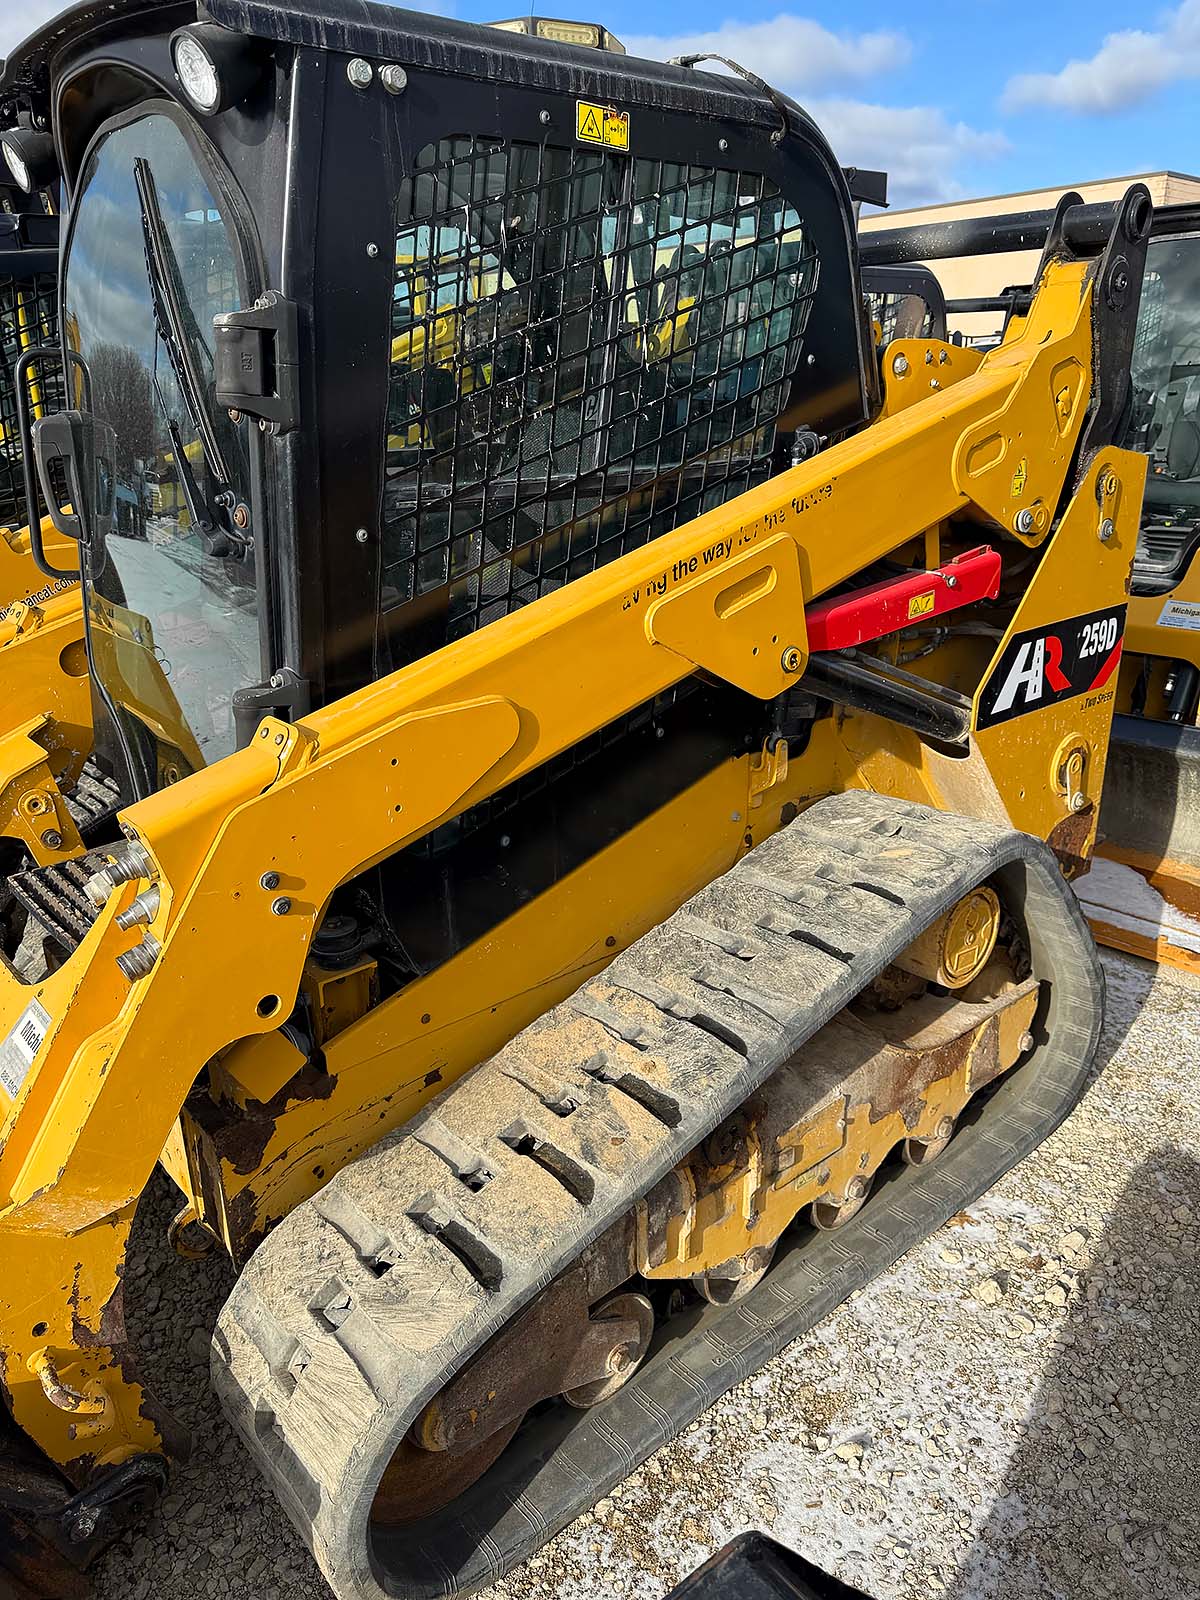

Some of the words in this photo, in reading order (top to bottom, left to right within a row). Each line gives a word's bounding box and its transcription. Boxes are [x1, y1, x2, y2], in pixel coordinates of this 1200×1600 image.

[672, 556, 698, 581] the
[702, 537, 733, 565] way
[1079, 617, 1118, 659] 259D
